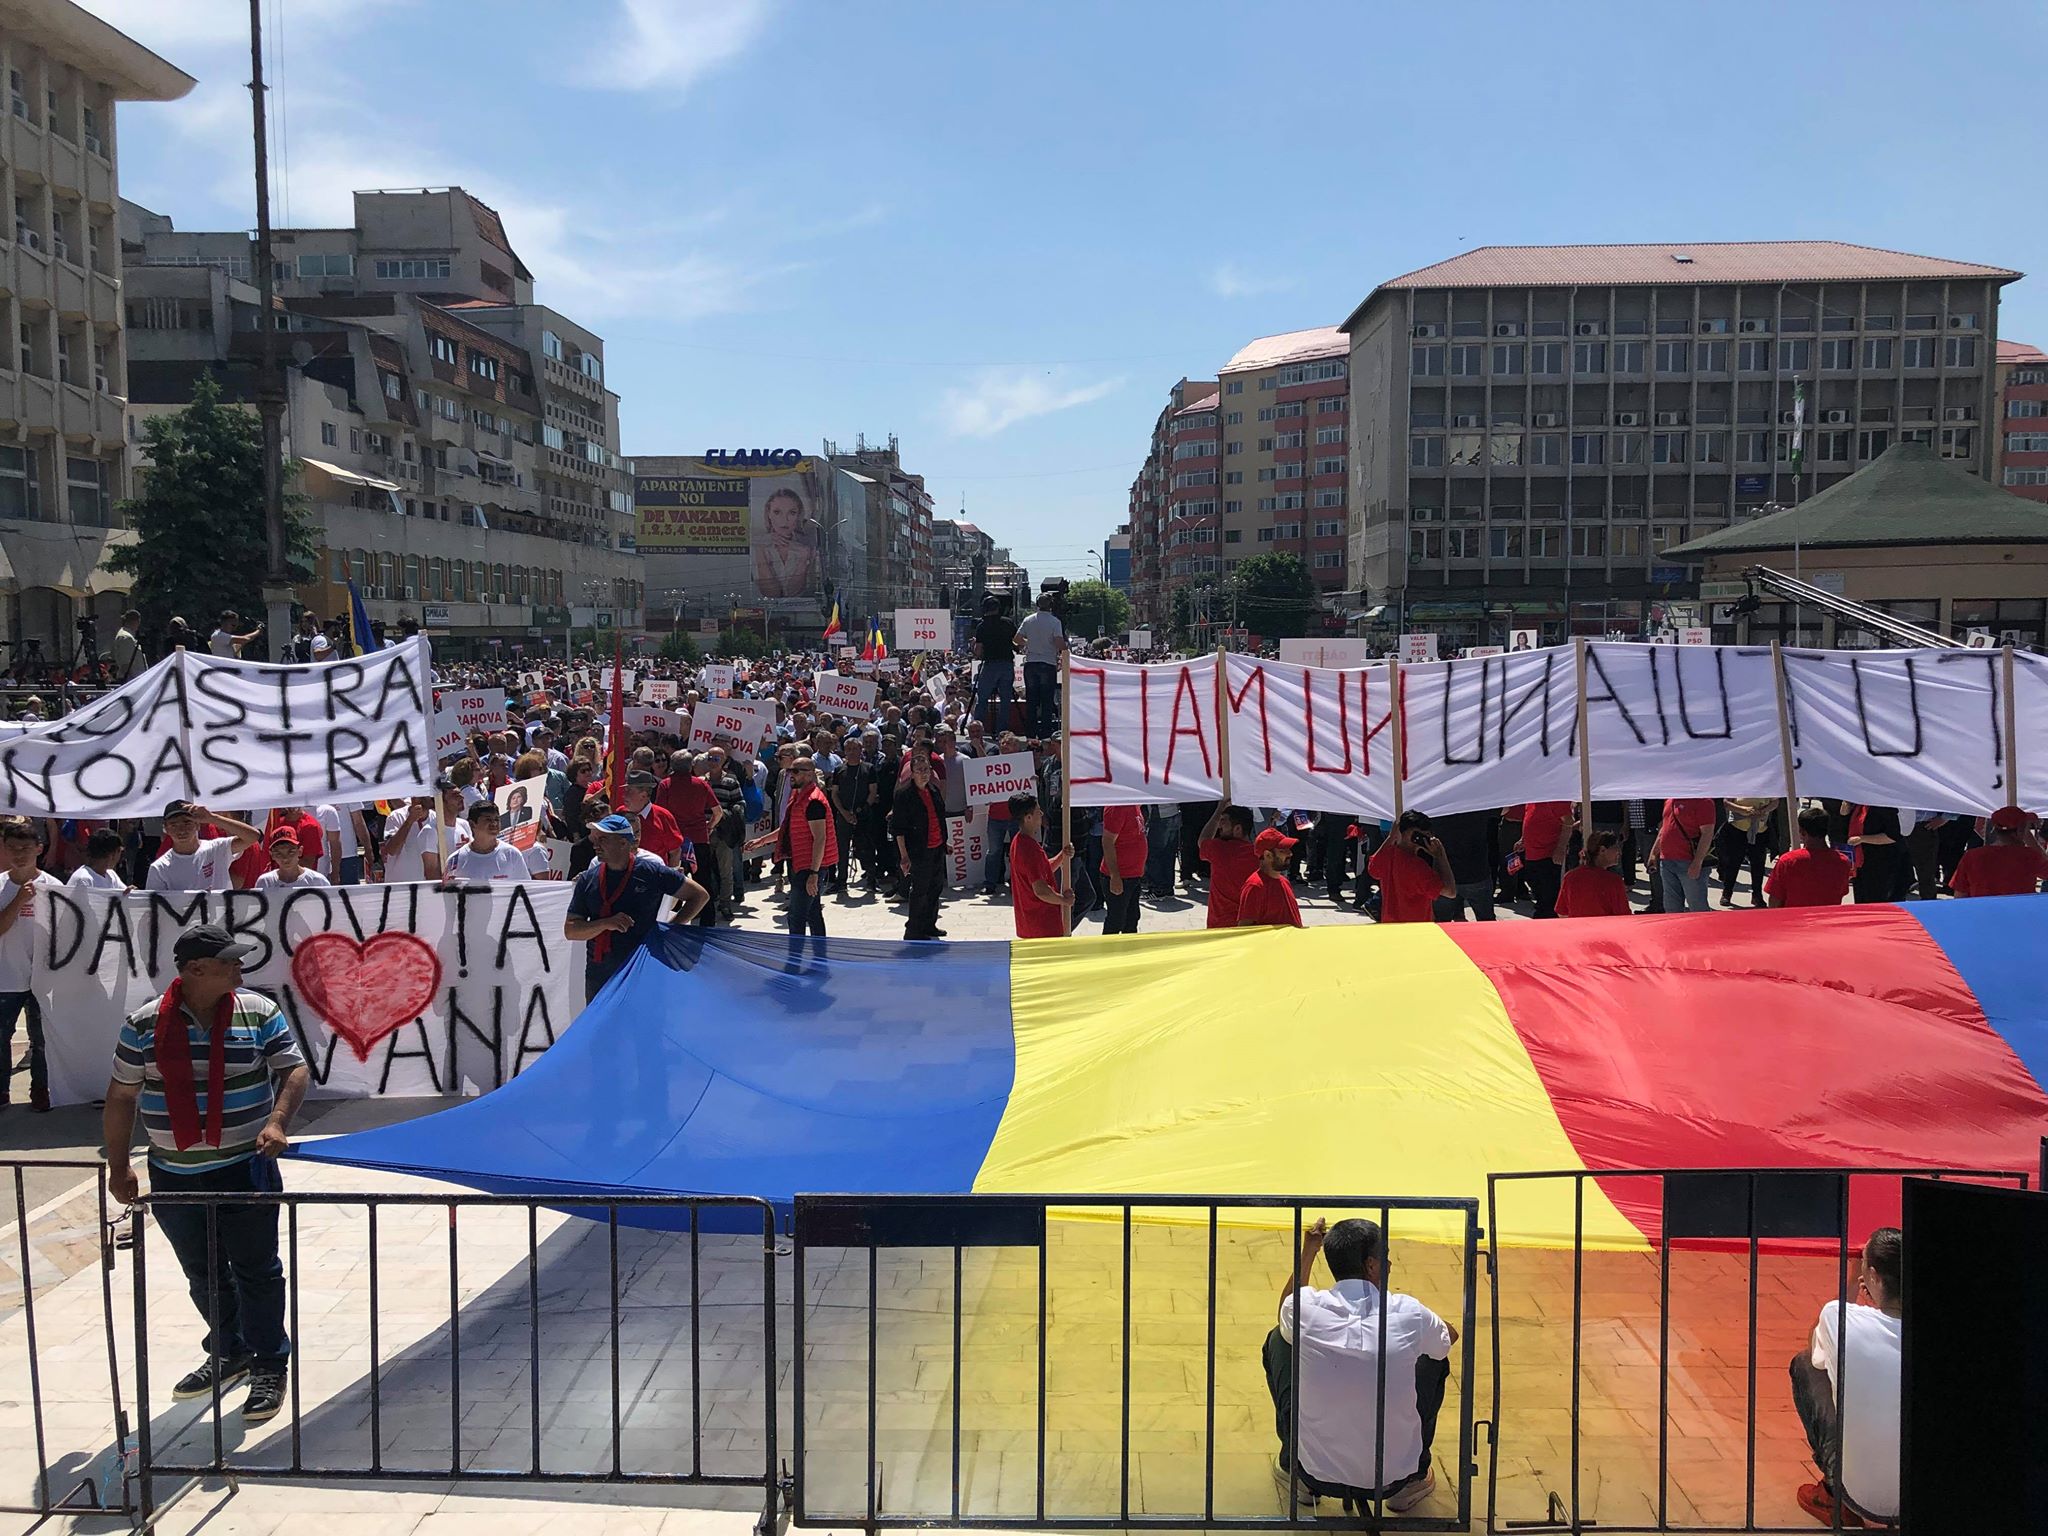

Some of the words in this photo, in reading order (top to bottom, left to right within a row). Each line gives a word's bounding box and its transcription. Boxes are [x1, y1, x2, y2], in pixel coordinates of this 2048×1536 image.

[704, 448, 803, 466] FLANCO
[639, 480, 745, 492] APARTAMENTE
[679, 492, 705, 504] NOI
[643, 510, 664, 523] DE
[668, 510, 740, 524] VANZARE
[688, 525, 746, 536] camere
[914, 630, 936, 639] PSD
[836, 683, 858, 695] PSD
[461, 697, 485, 710] PSD
[818, 695, 869, 712] PRAHOVA
[643, 715, 666, 728] PSD
[716, 715, 743, 732] PSD
[693, 729, 753, 755] PROVA
[2, 719, 424, 813] NOASTRA
[985, 763, 1012, 777] PSD
[969, 778, 1033, 797] PRAHOVA
[754, 818, 771, 833] PSD
[951, 820, 967, 882] PRAHOVA
[969, 836, 982, 862] PSD
